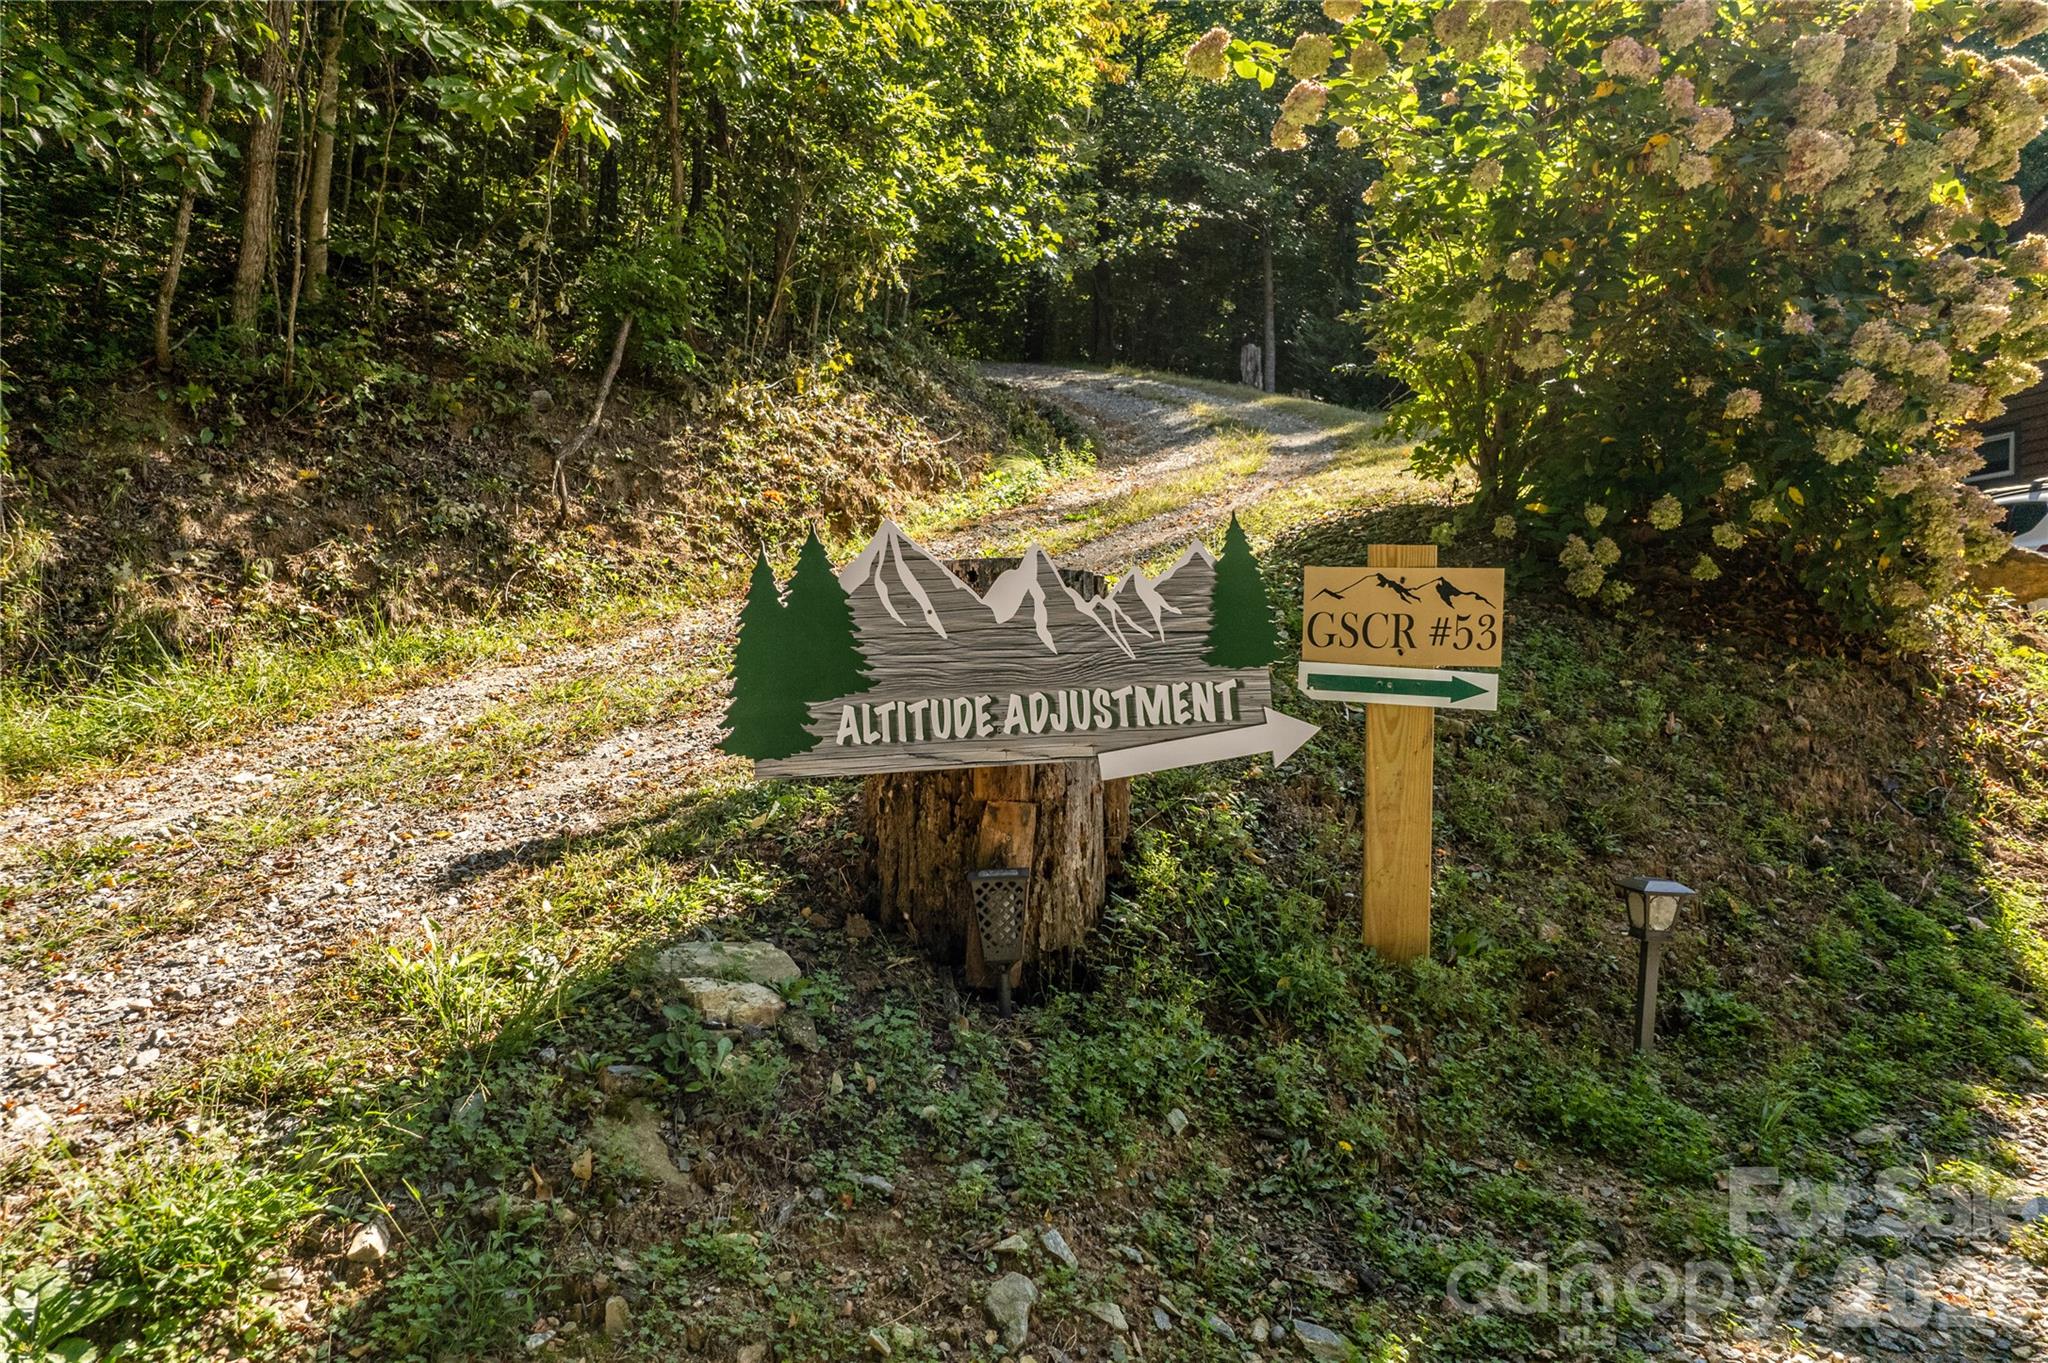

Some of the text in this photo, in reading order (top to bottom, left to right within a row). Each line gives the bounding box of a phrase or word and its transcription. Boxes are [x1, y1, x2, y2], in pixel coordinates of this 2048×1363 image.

[1307, 611, 1497, 651] GSCR #53
[836, 678, 1239, 746] ALTITUDE ADJUSTMENT
